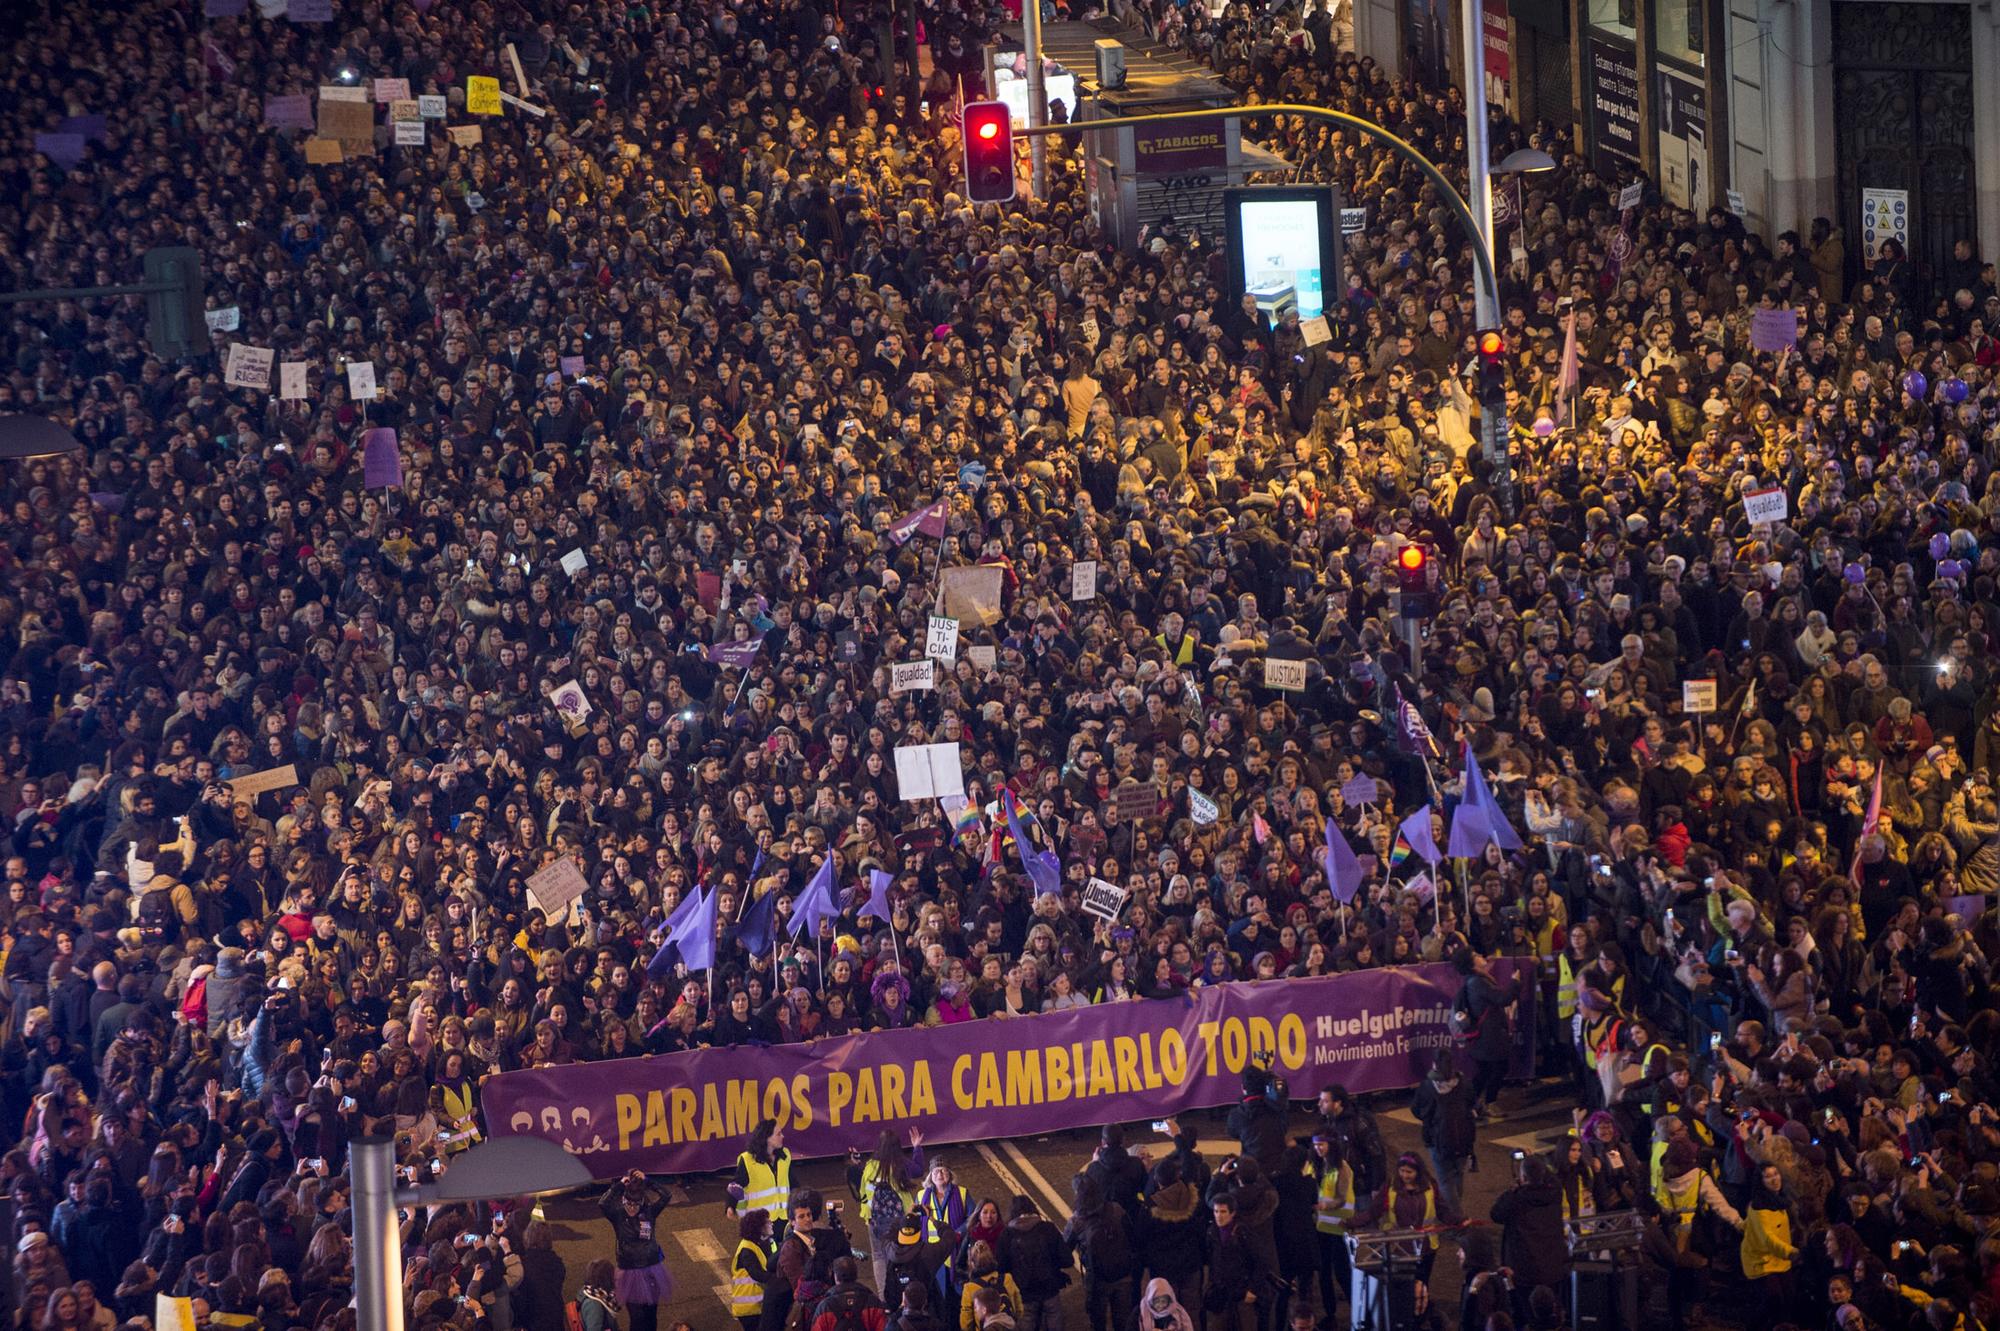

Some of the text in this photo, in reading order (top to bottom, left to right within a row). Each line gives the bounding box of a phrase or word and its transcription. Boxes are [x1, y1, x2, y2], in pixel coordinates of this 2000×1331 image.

[1595, 53, 1613, 72] Estamos
[1596, 93, 1603, 110] En
[1610, 102, 1618, 117] par
[1619, 102, 1626, 119] de
[1608, 121, 1632, 141] volvemos
[1155, 134, 1218, 149] TABACOS
[930, 618, 957, 631] JUS-
[936, 631, 949, 642] TI-
[929, 643, 953, 656] CIA!
[895, 664, 932, 687] ¡Igualdad!
[1085, 883, 1123, 913] ¡Justicia!
[1315, 1031, 1452, 1065] Movimiento Feminista
[616, 1012, 1307, 1150] PARAMOS PARA CAMBIARLO TODO
